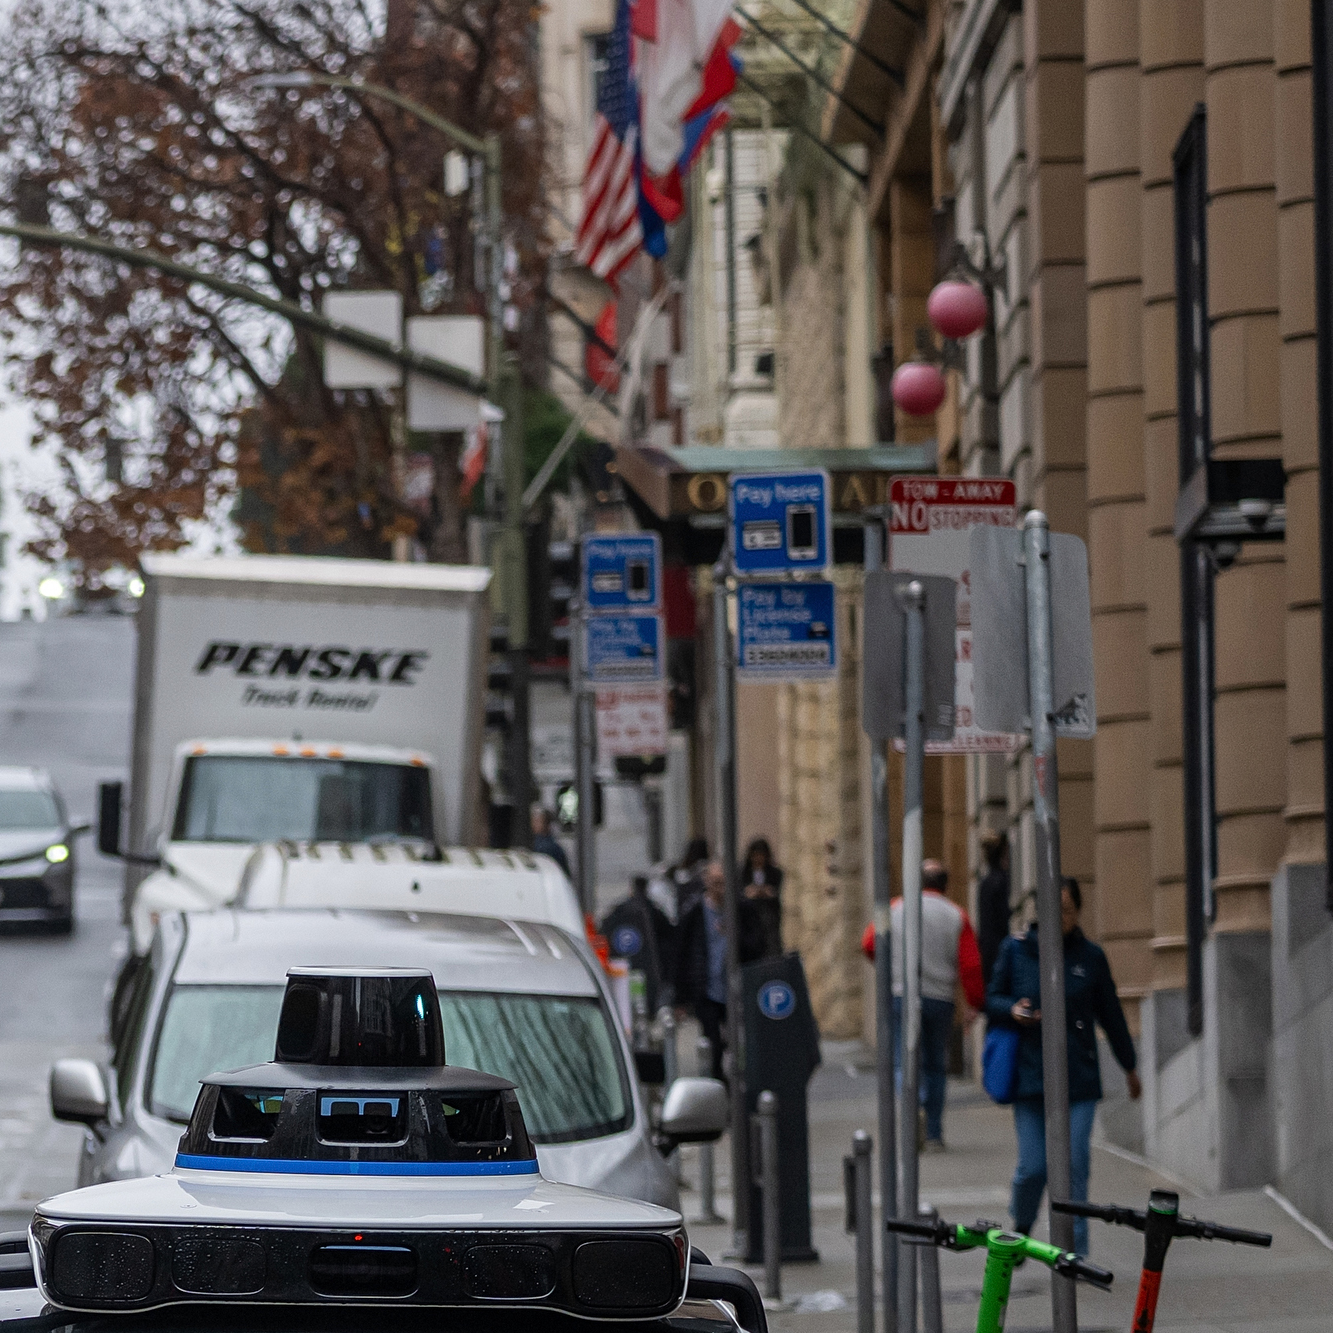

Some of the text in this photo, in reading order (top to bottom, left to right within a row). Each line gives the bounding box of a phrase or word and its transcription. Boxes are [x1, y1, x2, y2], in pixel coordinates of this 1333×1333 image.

[737, 483, 773, 508] Pay
[775, 481, 821, 502] here
[892, 501, 928, 531] NO
[742, 587, 804, 610] Pay by
[742, 608, 811, 624] License
[742, 626, 791, 642] Plate
[194, 640, 426, 686] PENSKE
[243, 684, 379, 712] Truck Rental
